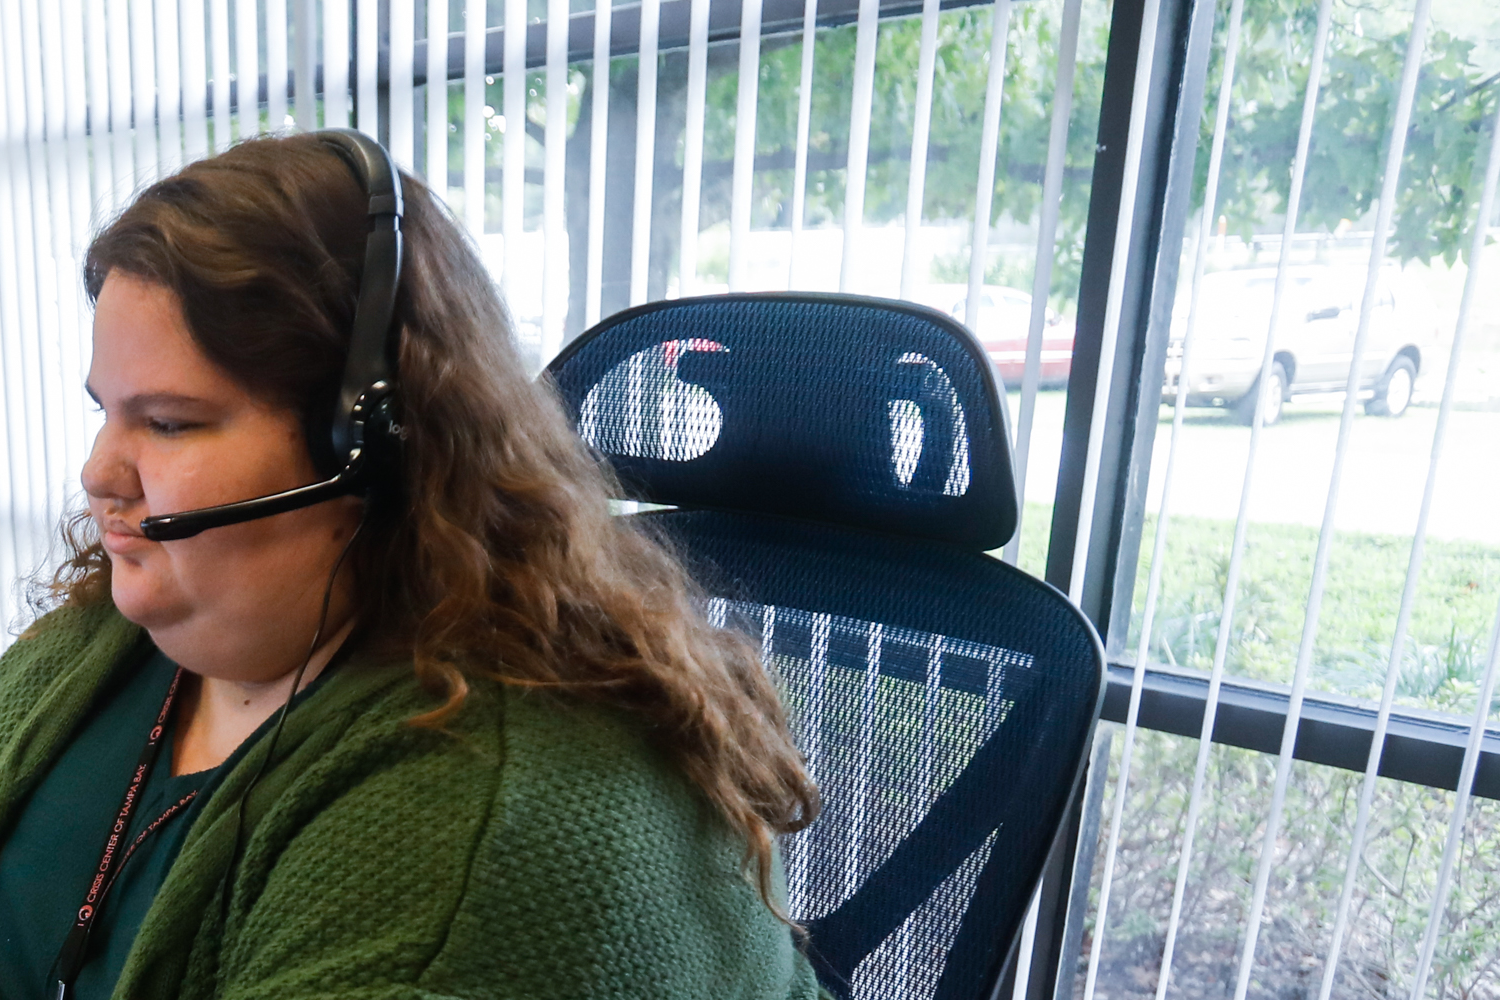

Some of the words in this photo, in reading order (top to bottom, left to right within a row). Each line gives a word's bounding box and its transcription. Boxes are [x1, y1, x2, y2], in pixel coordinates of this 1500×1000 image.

[87, 873, 105, 903] CRISIS
[100, 833, 119, 872] CENTER
[113, 818, 125, 833] OF
[120, 784, 139, 817] TAMPA
[148, 806, 178, 830] TAMPA
